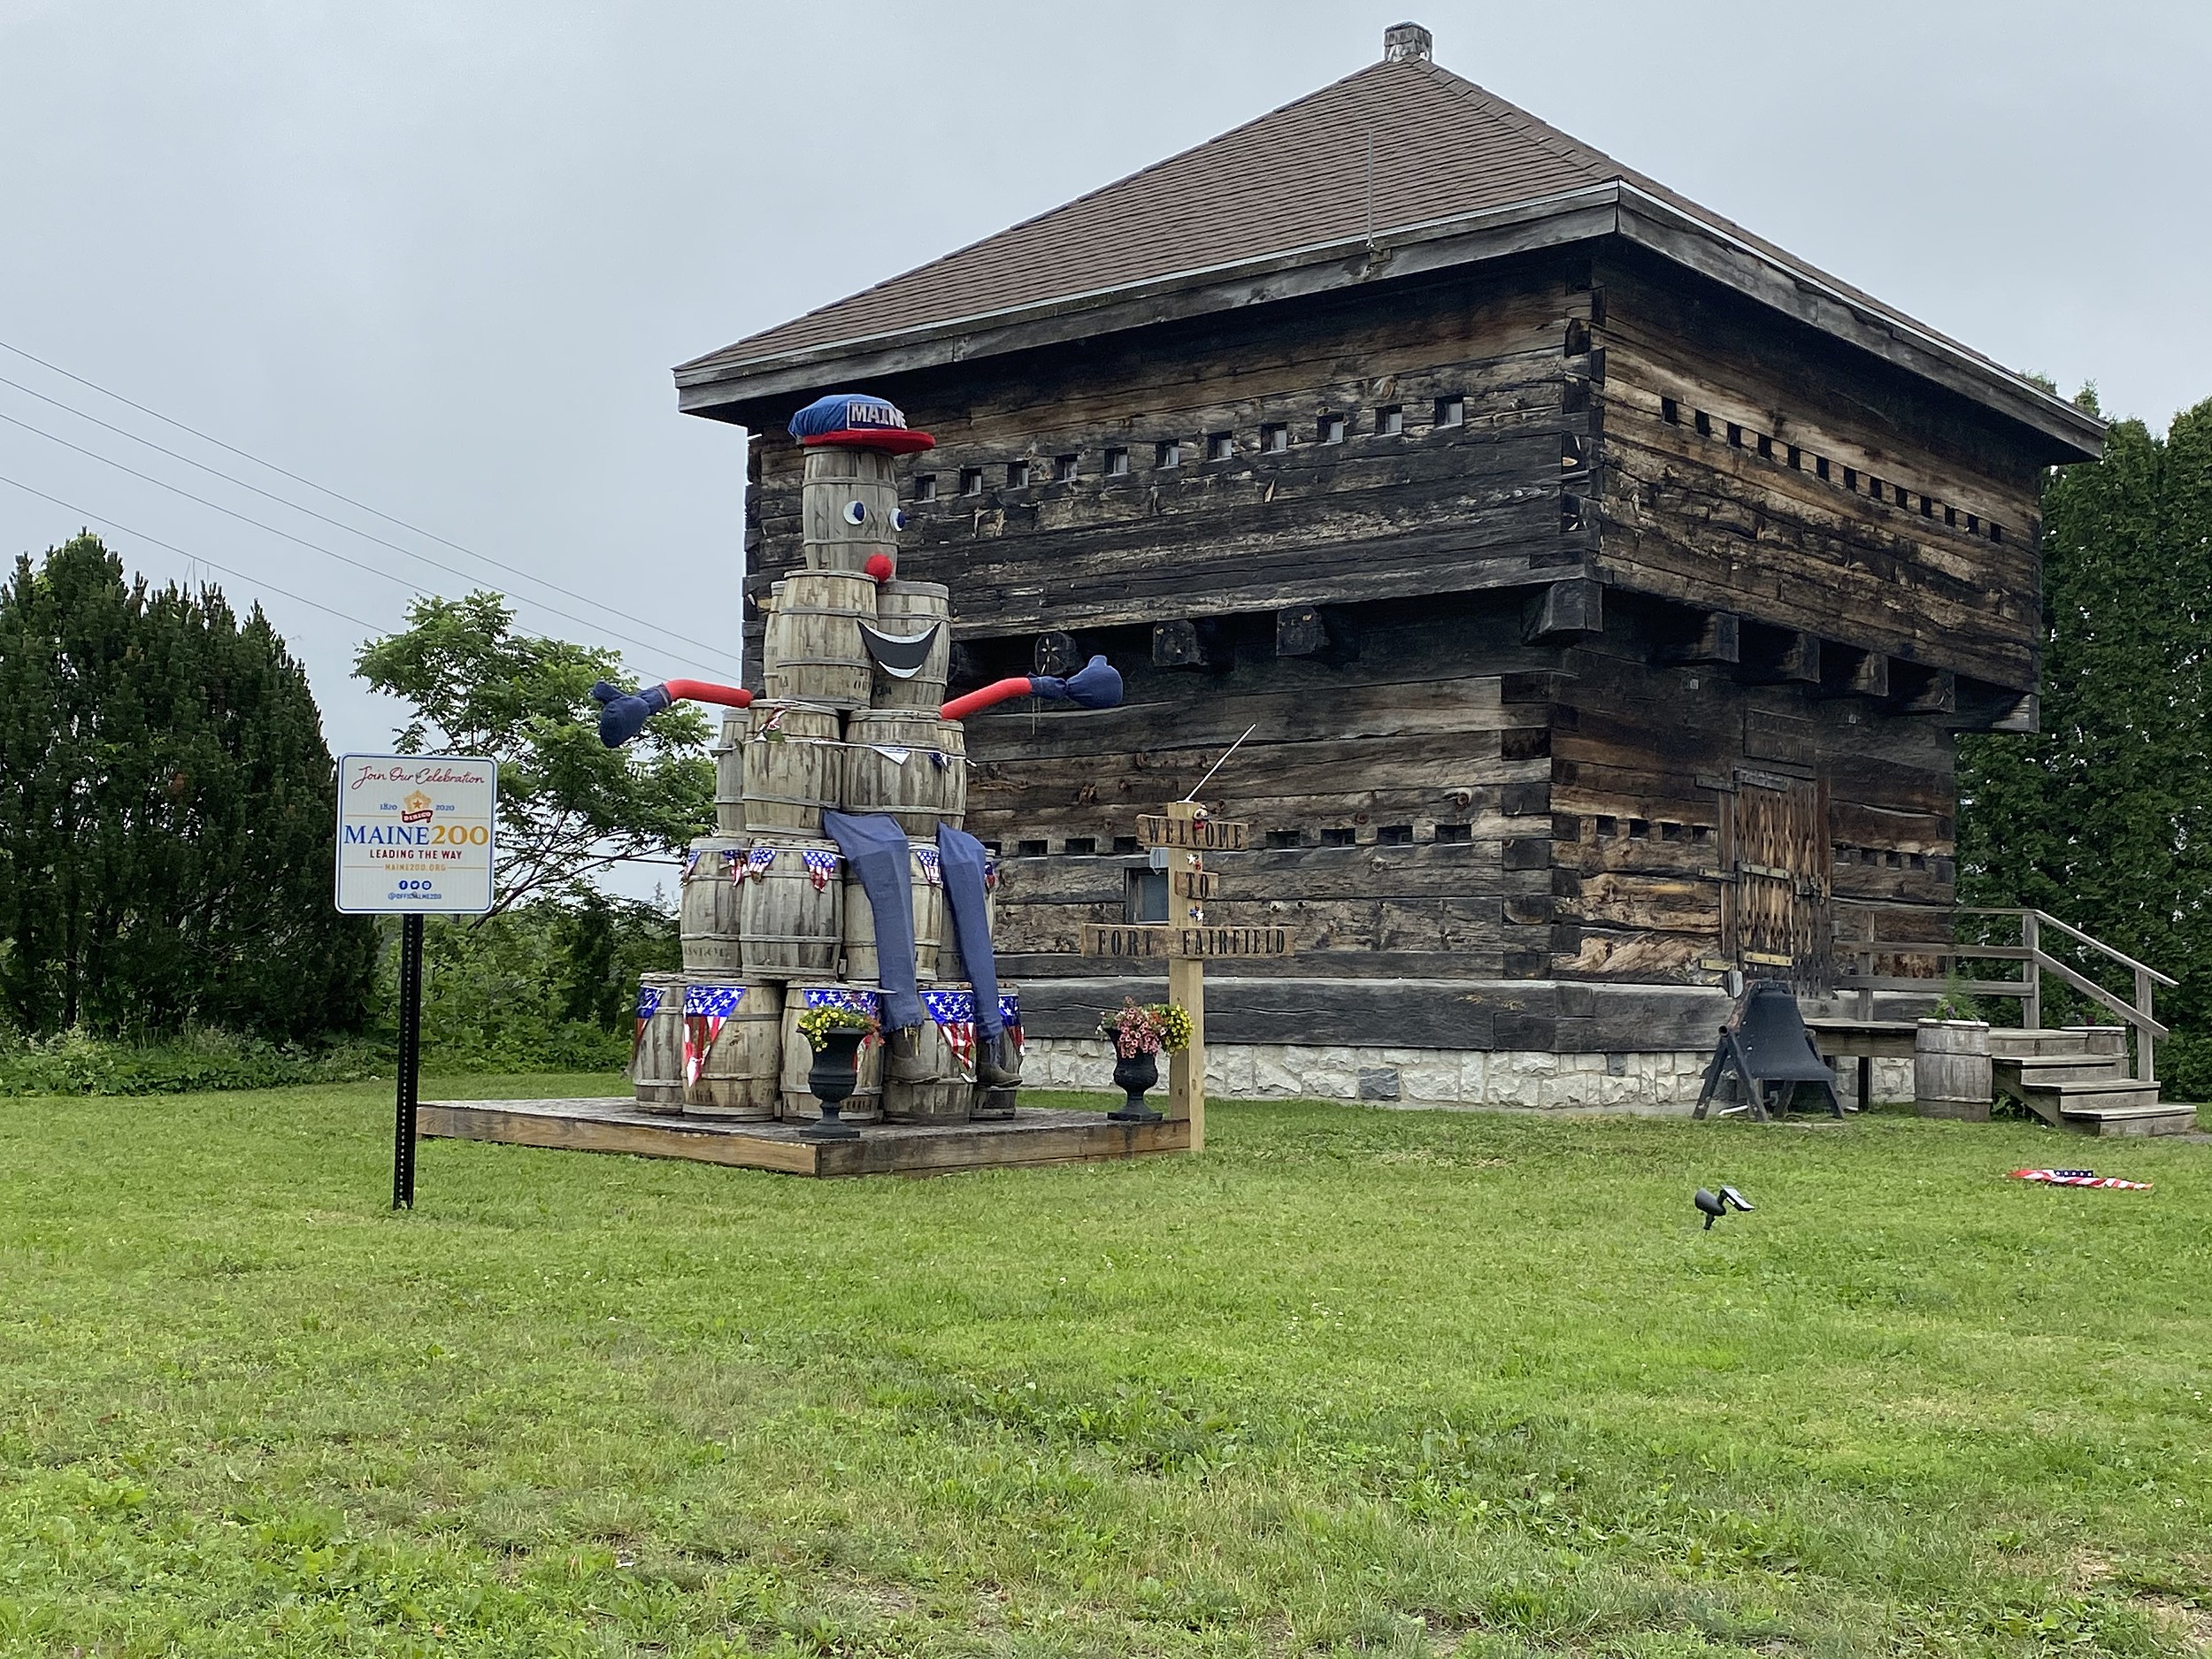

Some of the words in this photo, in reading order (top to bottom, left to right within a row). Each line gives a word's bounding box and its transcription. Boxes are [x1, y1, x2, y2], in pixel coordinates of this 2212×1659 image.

[850, 403, 907, 429] MAINE
[351, 765, 386, 790] Join
[389, 766, 414, 782] Our
[415, 767, 485, 785] Celebration
[343, 825, 489, 846] MAINE200
[1148, 817, 1242, 849] WELCOME
[369, 849, 414, 859] LEADING
[419, 849, 437, 859] THE
[442, 850, 463, 859] WAY
[1186, 872, 1210, 898] TO
[1097, 930, 1153, 956] FORT
[1182, 929, 1285, 955] FAIRFIELD
